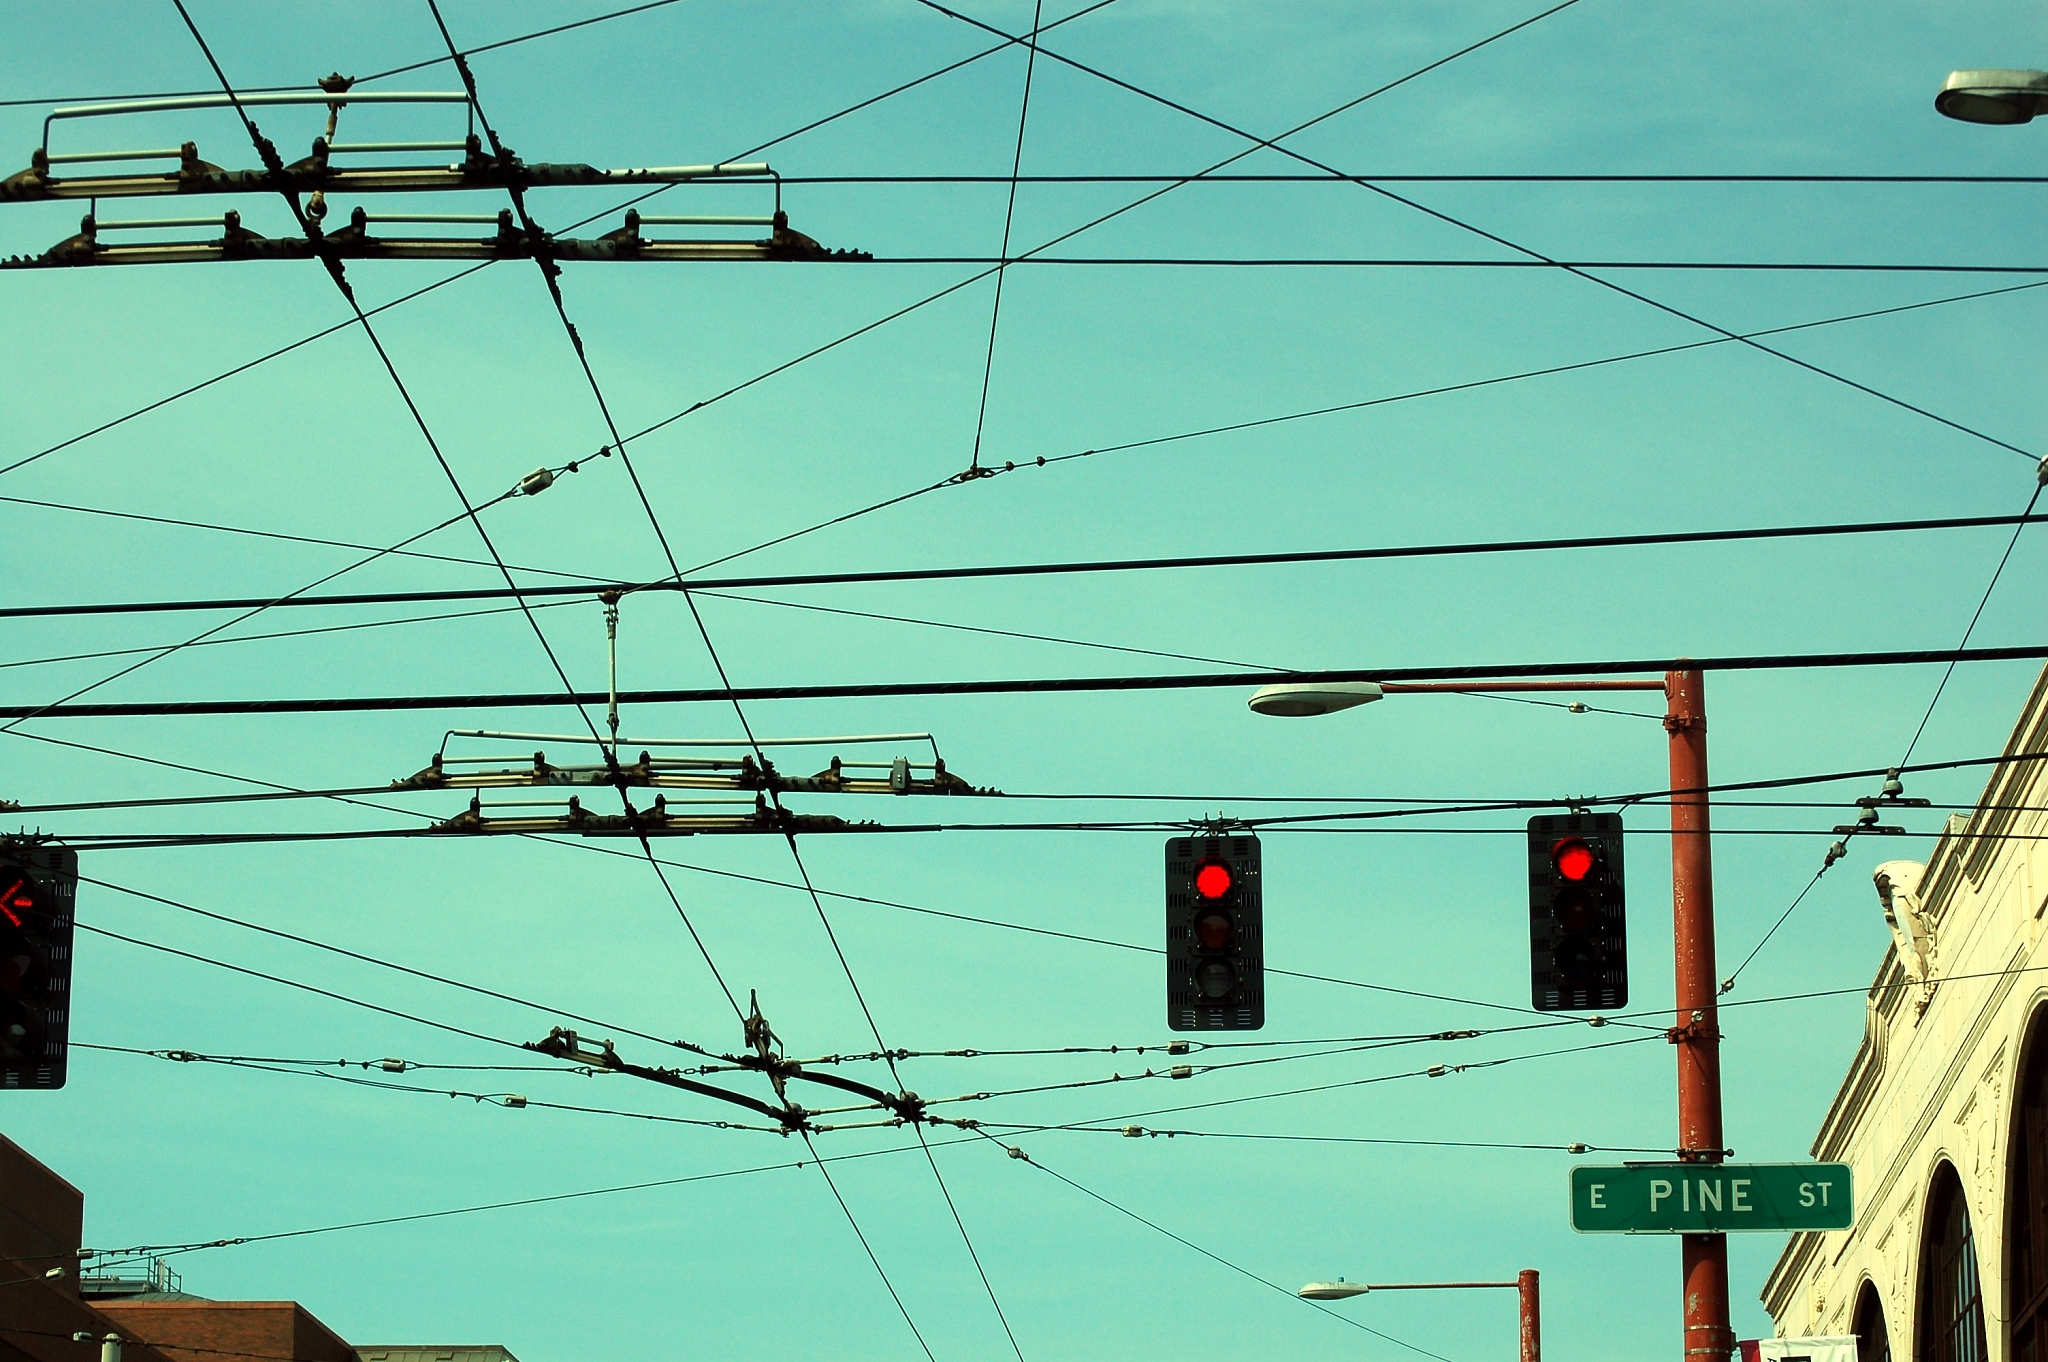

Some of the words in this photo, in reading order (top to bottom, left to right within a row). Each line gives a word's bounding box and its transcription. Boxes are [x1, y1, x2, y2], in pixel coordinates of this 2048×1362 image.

[1590, 1184, 1606, 1208] E
[1650, 1179, 1752, 1212] PINE
[1798, 1182, 1832, 1207] ST
